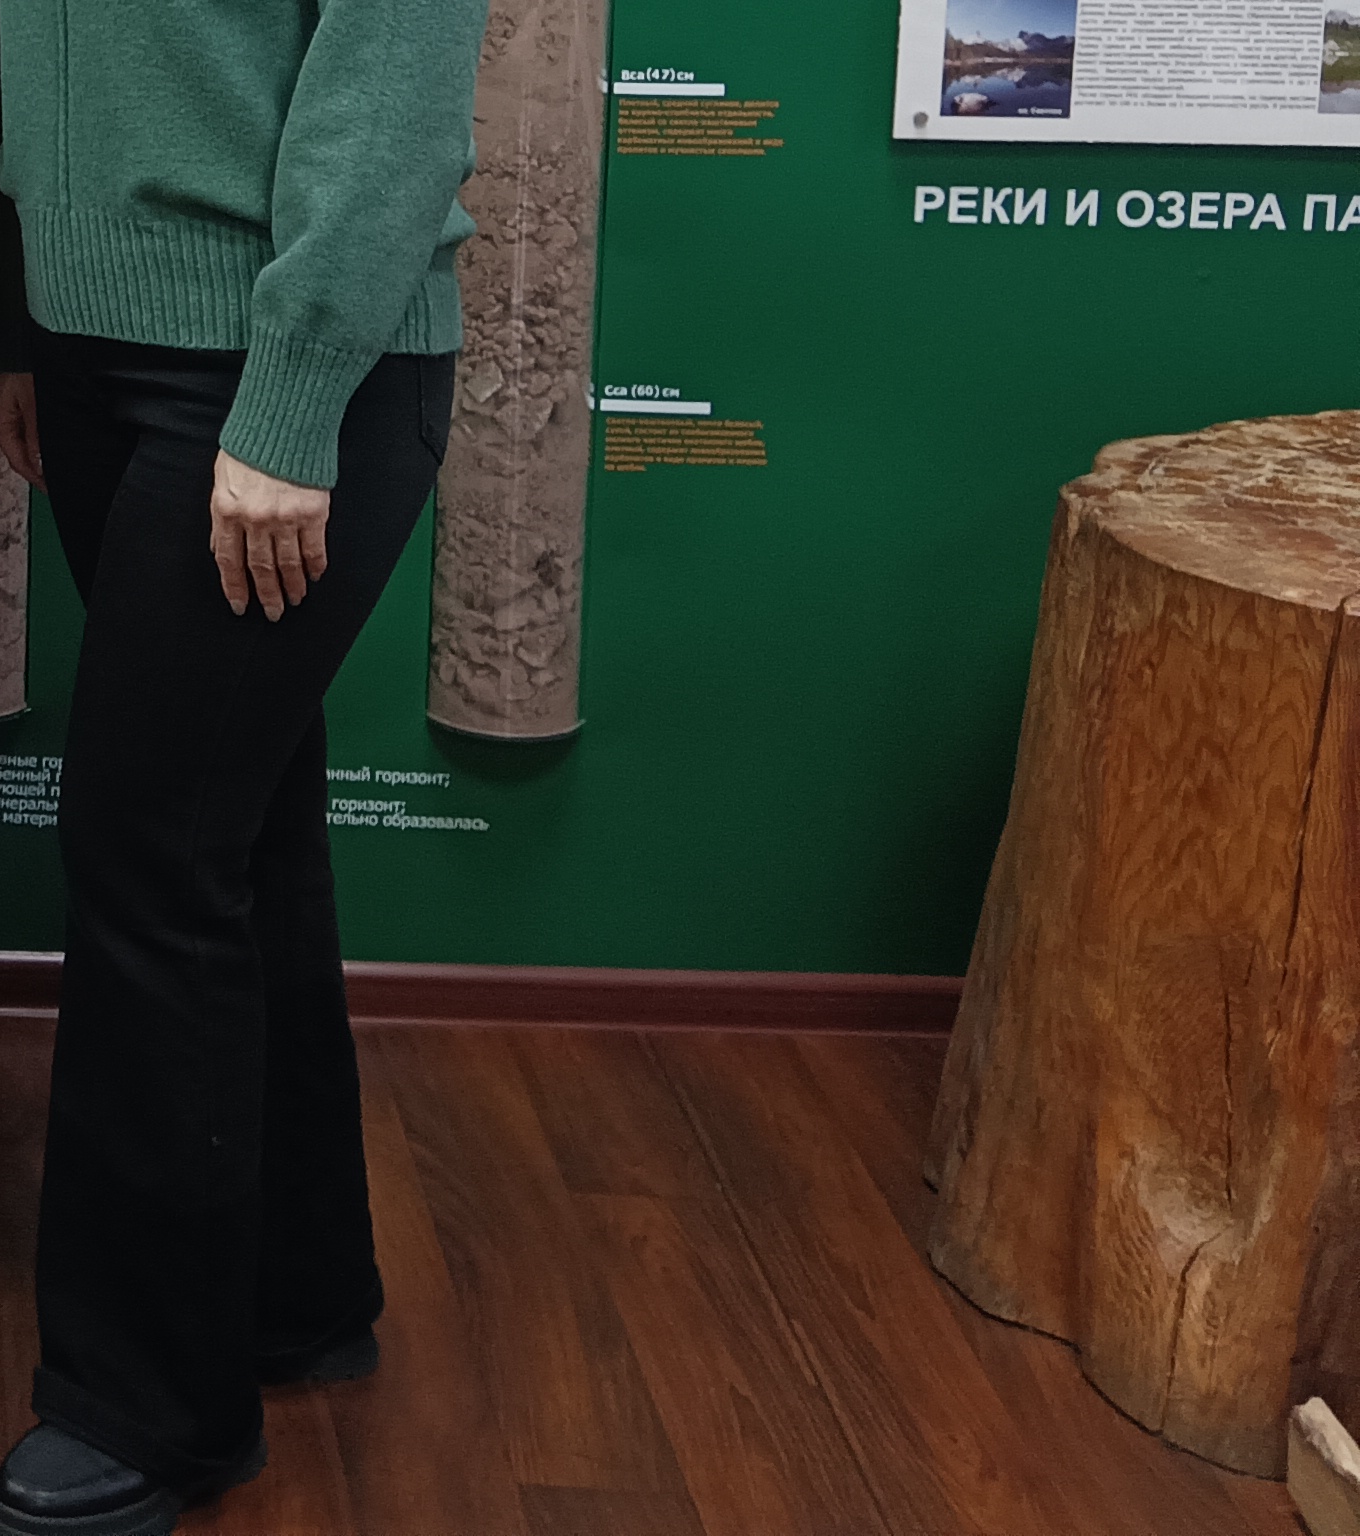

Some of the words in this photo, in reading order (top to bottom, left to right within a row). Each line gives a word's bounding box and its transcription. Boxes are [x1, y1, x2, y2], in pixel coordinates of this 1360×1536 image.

[913, 185, 1047, 226] РЕКИ
[1065, 188, 1099, 227] И
[1116, 189, 1287, 231] ОЗЕРА
[374, 770, 450, 788] горизонт;
[331, 798, 407, 814] горизонт;
